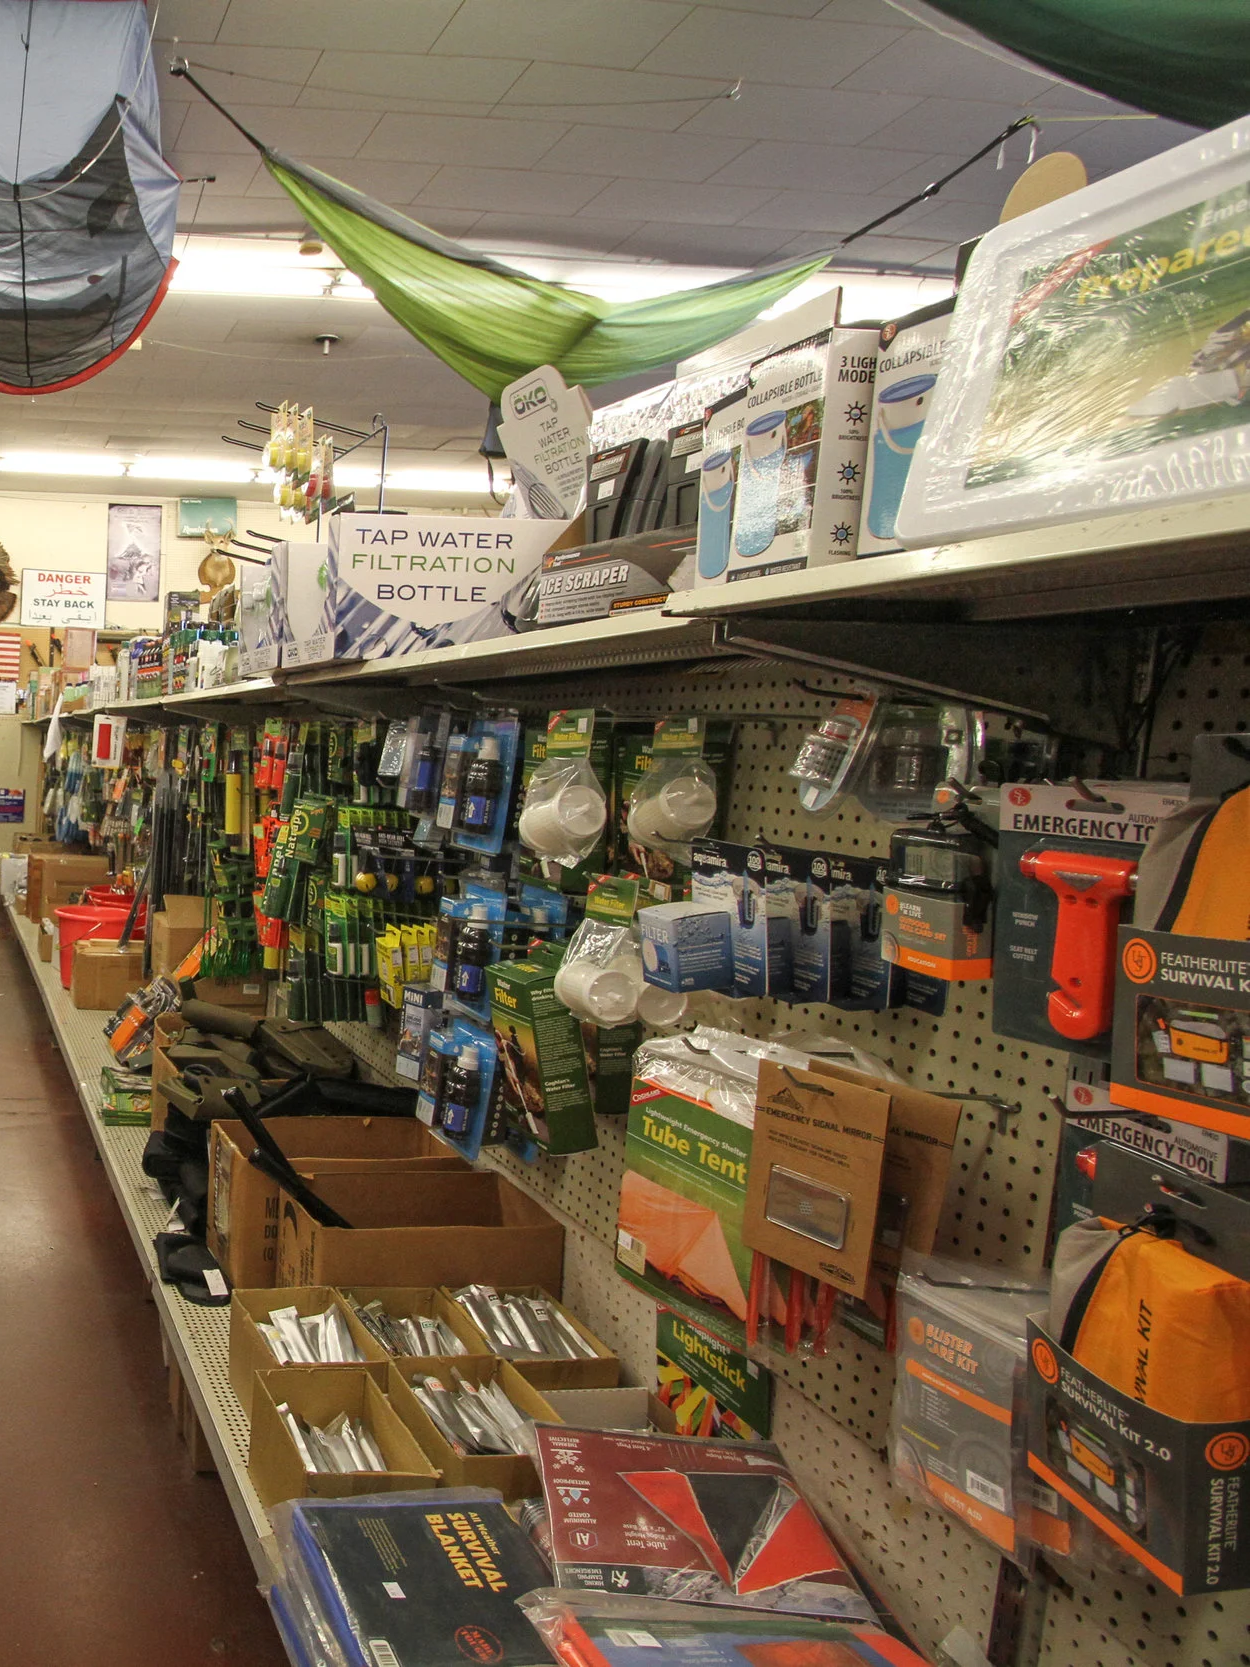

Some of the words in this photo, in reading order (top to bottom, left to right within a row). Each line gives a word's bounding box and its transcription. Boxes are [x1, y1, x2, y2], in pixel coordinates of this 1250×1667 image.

[841, 356, 848, 368] 3
[851, 356, 876, 370] LIGH
[879, 340, 948, 373] COLLAPSIBLE
[838, 369, 875, 384] MODE
[747, 379, 794, 409] COLLAPSIBLE
[794, 371, 823, 392] BOTTLE
[540, 417, 559, 432] TAP
[538, 427, 571, 448] WATER
[534, 436, 586, 465] FILTRATION
[545, 452, 583, 475] BOTTLE
[355, 528, 408, 545] TAP
[418, 531, 513, 549] WATER
[352, 554, 515, 574] FILTRATION
[38, 573, 92, 584] DANGER
[542, 577, 562, 596] ICE
[566, 565, 630, 591] SCRAPER
[33, 598, 60, 608] STAY
[64, 600, 94, 609] BACK
[377, 584, 487, 602] BOTTLE
[285, 803, 303, 859] Natrapel
[1013, 813, 1130, 841] EMERGENCY
[640, 924, 668, 945] FILTER
[496, 978, 511, 990] Water
[1161, 968, 1233, 990] SURVIVAL
[404, 989, 423, 1005] MINI
[494, 987, 518, 1008] Filter
[646, 1106, 682, 1129] Lightweight
[683, 1123, 720, 1147] Emergency
[721, 1141, 747, 1159] Shelter
[765, 1106, 810, 1125] EMERGENCY
[812, 1118, 840, 1133] SIGNAL
[842, 1125, 873, 1141] MIRROR
[642, 1115, 691, 1156] Tube
[697, 1142, 748, 1185] Tent
[1077, 1115, 1174, 1159] EMERGENCY
[1178, 1150, 1217, 1179] TOOL
[1174, 1136, 1218, 1162] AUTOMOTIVE
[1136, 1299, 1153, 1343] KIT
[926, 1323, 974, 1357] BLISTER
[673, 1320, 746, 1393] Lightstick
[926, 1339, 954, 1365] CARE
[956, 1359, 978, 1375] KIT
[1061, 1380, 1117, 1430] SURVIVAL
[1120, 1424, 1142, 1446] KIT
[1145, 1439, 1171, 1461] 2.0
[548, 1435, 582, 1443] REFLECTIVE
[551, 1440, 578, 1448] THERMAL
[553, 1478, 591, 1486] WATERPROOF
[564, 1516, 597, 1524] ALUMINUM
[1208, 1478, 1224, 1542] SURVIVAL
[468, 1511, 482, 1523] All
[476, 1523, 501, 1556] Weather
[626, 1538, 646, 1547] Tent
[647, 1540, 668, 1550] Tube
[425, 1513, 484, 1589] BLANKET
[446, 1512, 508, 1593] SURVIVAL
[1207, 1543, 1220, 1569] KIT
[1206, 1569, 1219, 1585] 2.0
